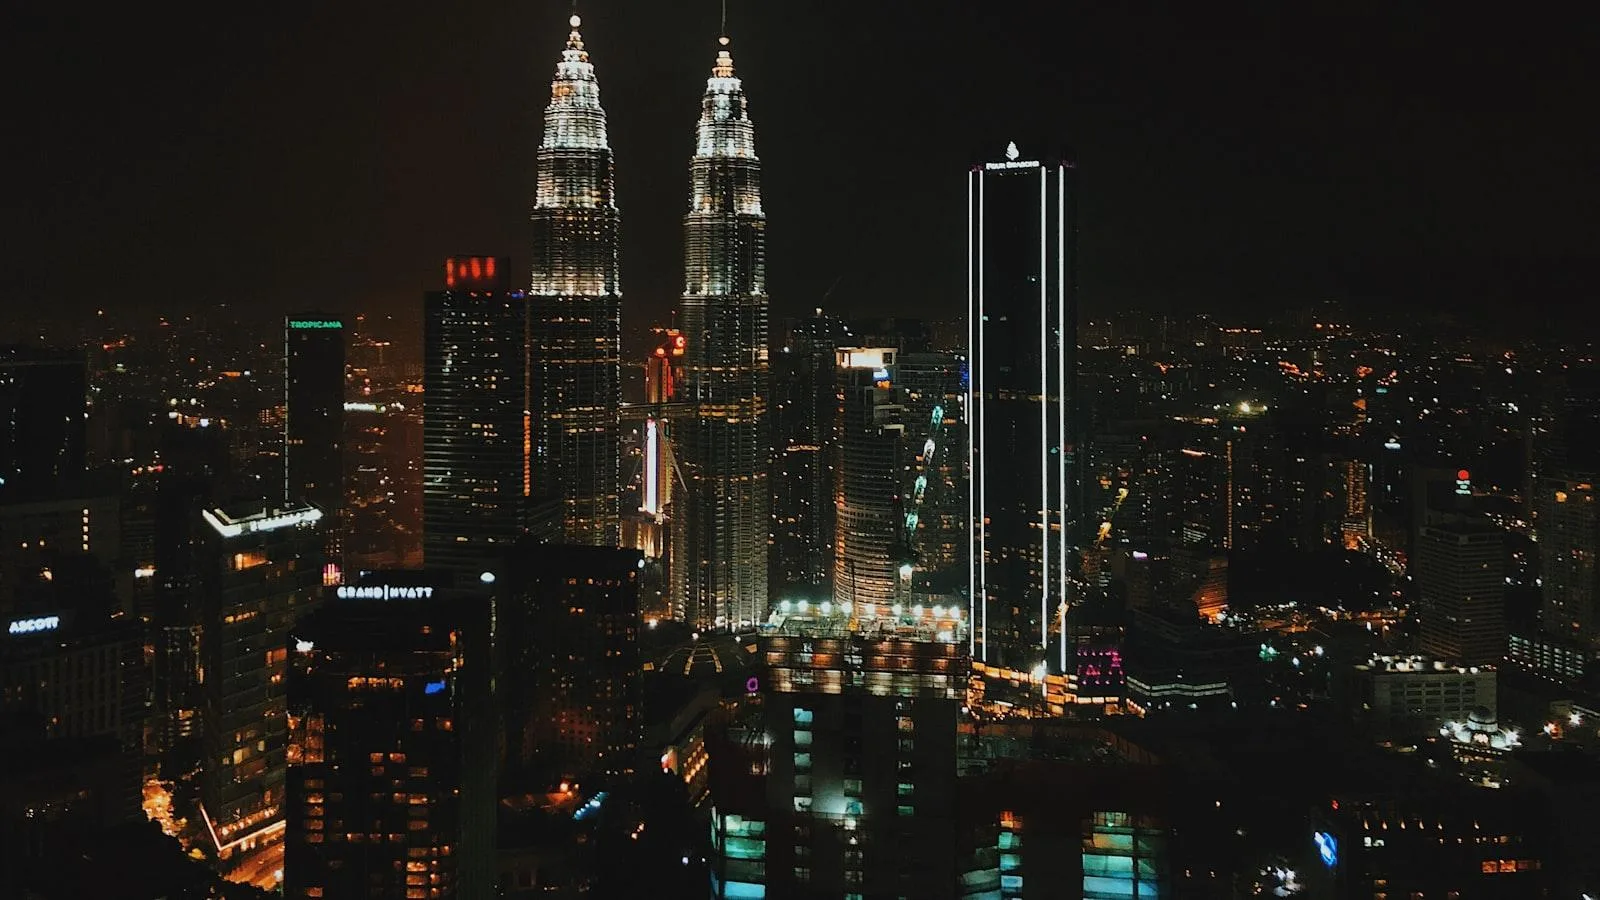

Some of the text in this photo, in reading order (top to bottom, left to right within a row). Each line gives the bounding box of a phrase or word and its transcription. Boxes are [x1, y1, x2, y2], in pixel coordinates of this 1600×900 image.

[289, 320, 343, 329] TROPICANA
[337, 586, 383, 599] GRAND
[9, 616, 60, 633] ASCOTT
